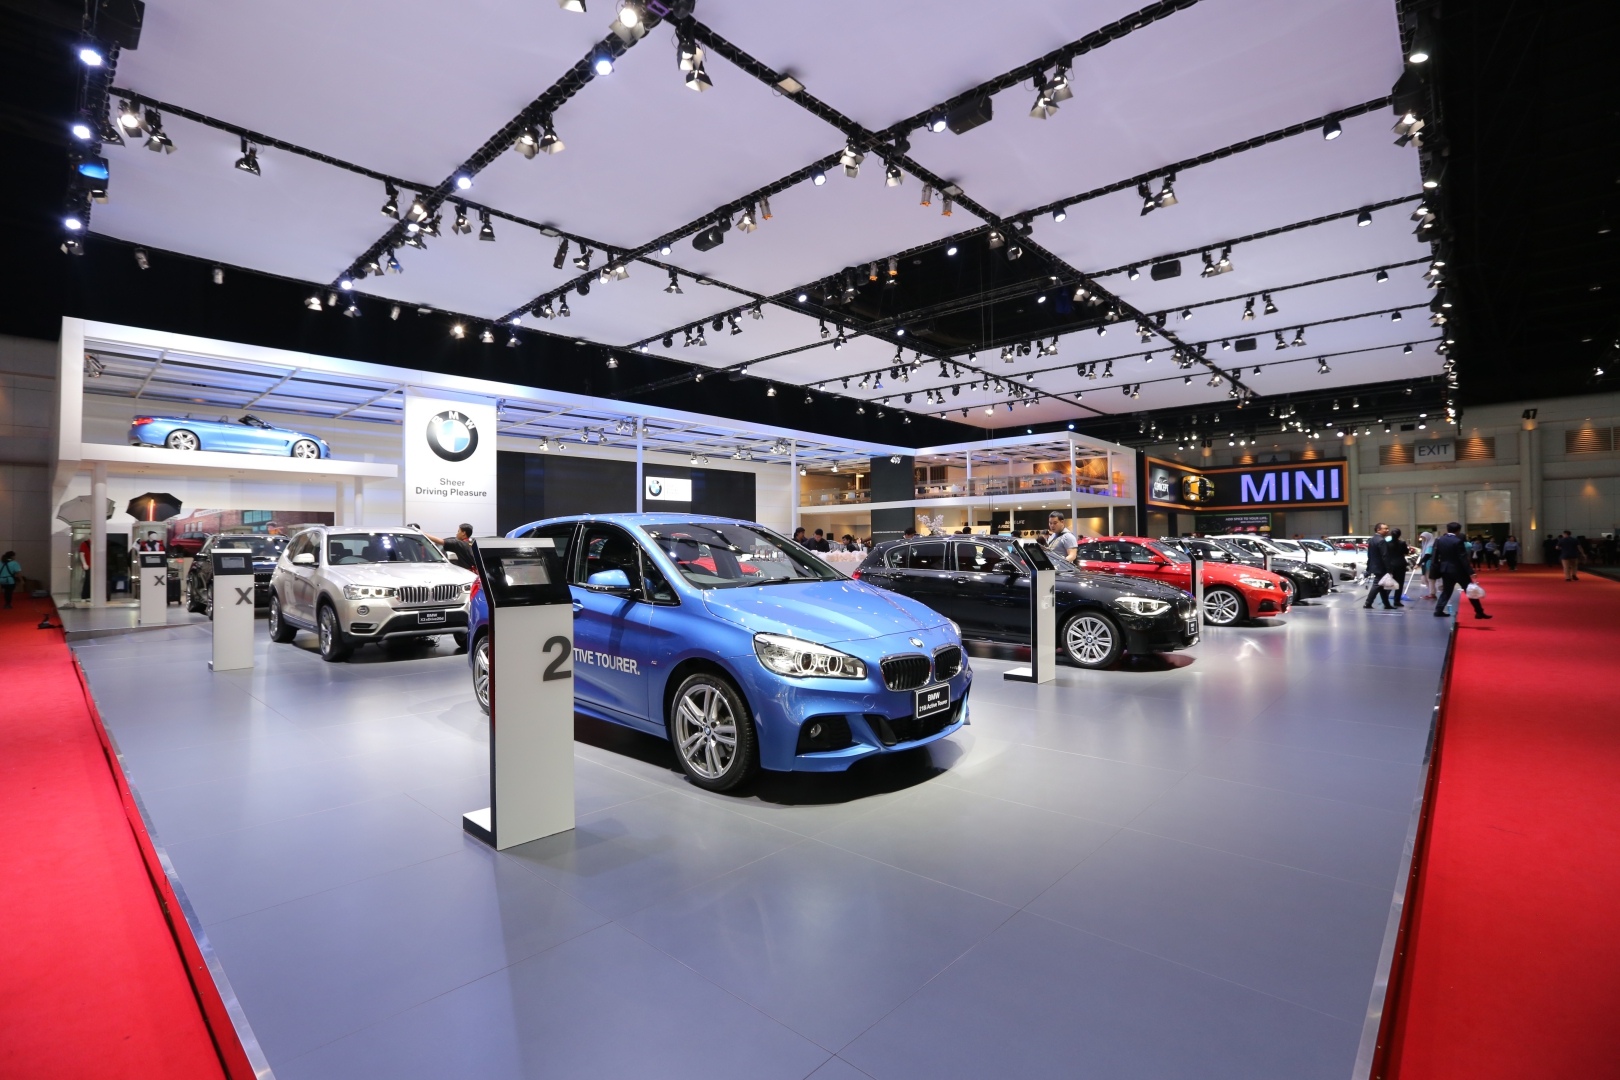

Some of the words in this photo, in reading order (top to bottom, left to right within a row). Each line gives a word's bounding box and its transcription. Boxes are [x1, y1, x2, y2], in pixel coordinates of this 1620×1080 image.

[1522, 408, 1538, 420] 47
[431, 411, 476, 430] BMW
[1418, 444, 1450, 456] EXIT
[440, 478, 465, 486] Sheer
[1241, 468, 1339, 503] MINI
[415, 486, 448, 497] Driving
[450, 488, 487, 497] Pleasure
[154, 575, 165, 586] X
[235, 587, 253, 605] X
[542, 635, 572, 682] 2
[573, 647, 594, 665] TIVE
[595, 652, 640, 675] TOURER.
[928, 692, 940, 702] BMW
